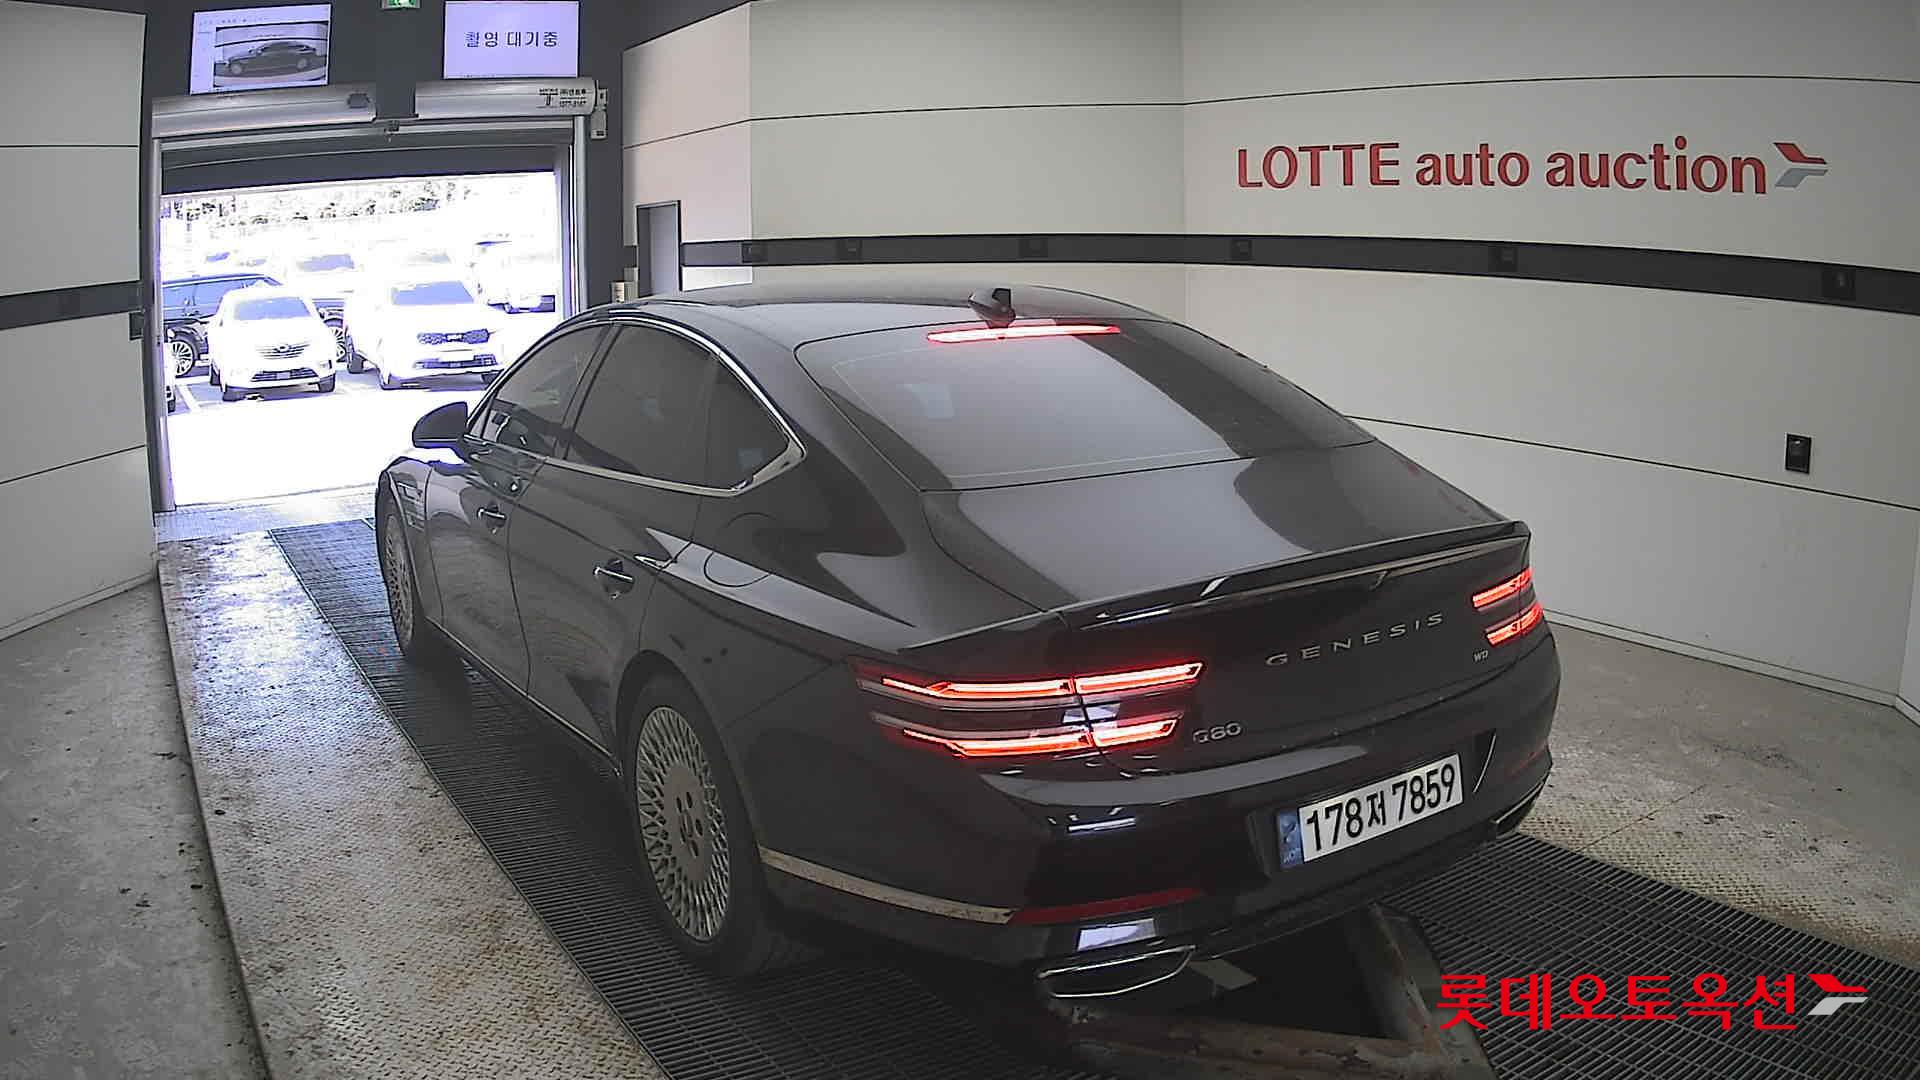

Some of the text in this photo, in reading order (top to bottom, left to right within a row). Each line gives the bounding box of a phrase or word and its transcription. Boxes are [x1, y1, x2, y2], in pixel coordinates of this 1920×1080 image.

[507, 31, 558, 48] 대기중
[1236, 135, 1767, 195] LOTTE auto auction
[1265, 613, 1443, 666] GENESIS
[1306, 763, 1455, 851] 178저 7859
